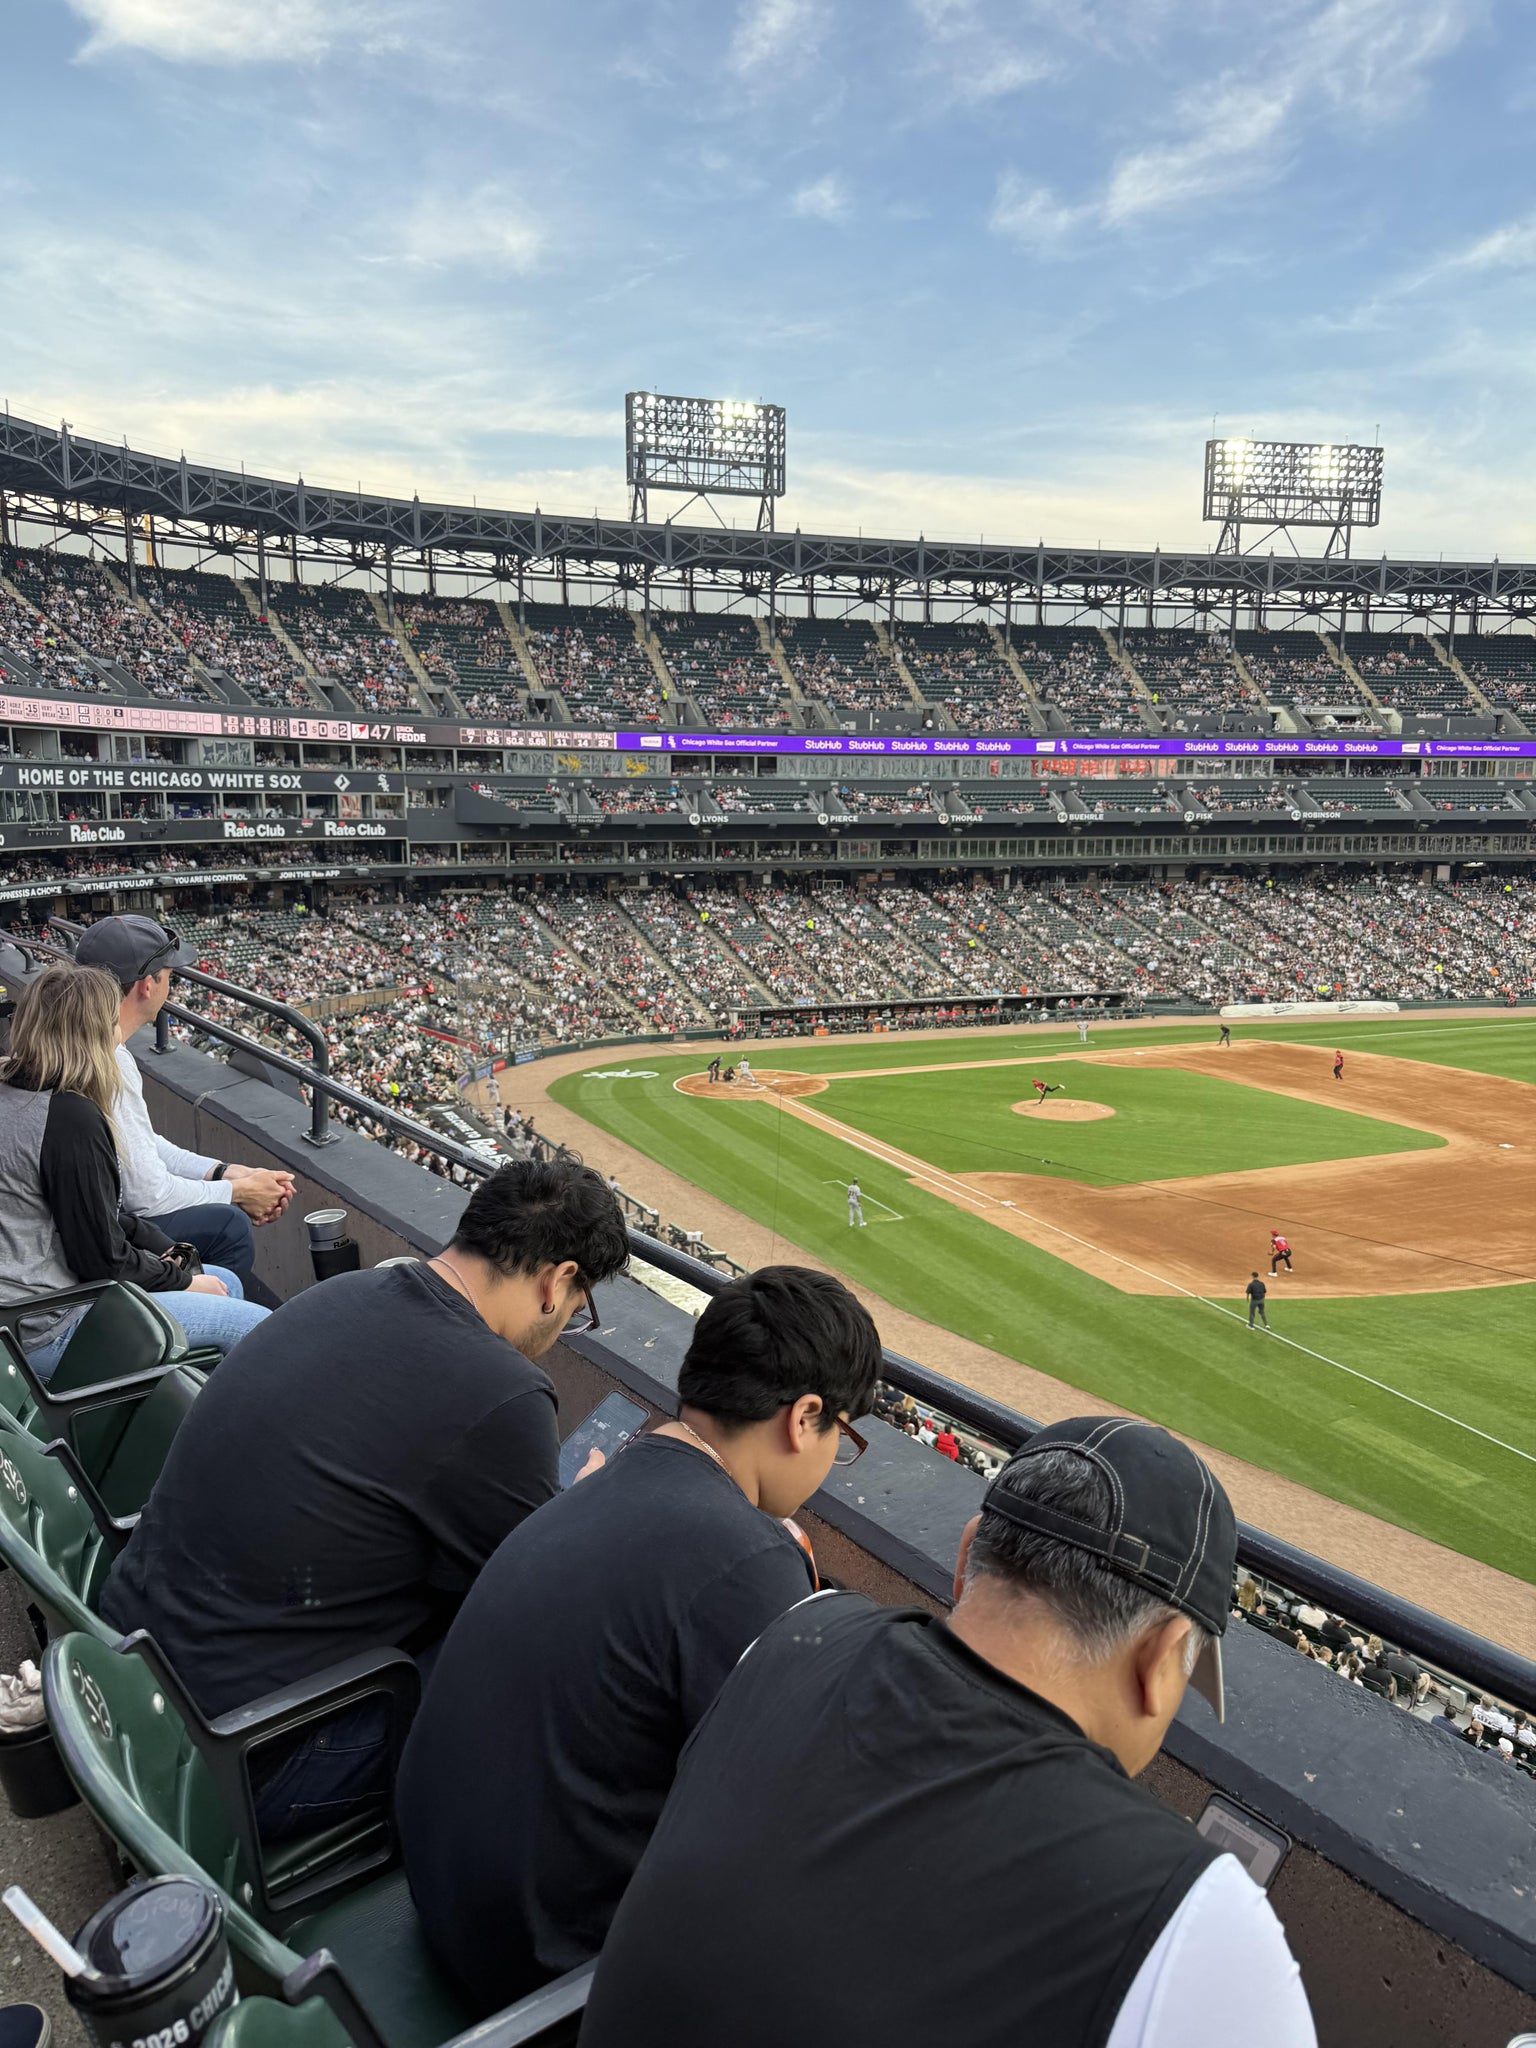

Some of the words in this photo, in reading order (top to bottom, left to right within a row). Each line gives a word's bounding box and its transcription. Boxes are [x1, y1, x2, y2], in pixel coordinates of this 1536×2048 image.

[370, 725, 391, 740] 47
[396, 733, 427, 743] FEDDE
[682, 738, 706, 746] Chicago
[804, 740, 842, 750] StubHub
[848, 740, 885, 750] StubHub
[891, 741, 928, 750] StubHub
[934, 741, 970, 751] StubHub
[976, 742, 1011, 752] StubHub
[1072, 742, 1094, 750] Chicago
[1184, 742, 1219, 752] StubHub
[1224, 743, 1259, 752] StubHub
[1264, 743, 1299, 752] StubHub
[1305, 743, 1338, 752] StubHub
[1344, 744, 1378, 752] StubHub
[18, 768, 64, 785] HOME
[69, 770, 89, 786] OF
[93, 771, 124, 786] THE
[130, 772, 202, 787] CHICAGO
[208, 774, 265, 788] WHITE
[269, 774, 302, 788] SOX
[70, 824, 98, 842] Rate
[98, 826, 125, 841] Club
[224, 821, 256, 838] Rate
[256, 824, 286, 837] Club
[324, 820, 356, 836] Rate
[357, 824, 386, 836] Club
[174, 876, 189, 884] YOU
[190, 876, 203, 884] ARE
[212, 874, 248, 882] CONTROL
[296, 870, 310, 878] THE
[92, 882, 104, 890] THE
[105, 881, 119, 890] LIFE
[119, 880, 134, 888] YOU
[36, 886, 62, 896] CHOICE
